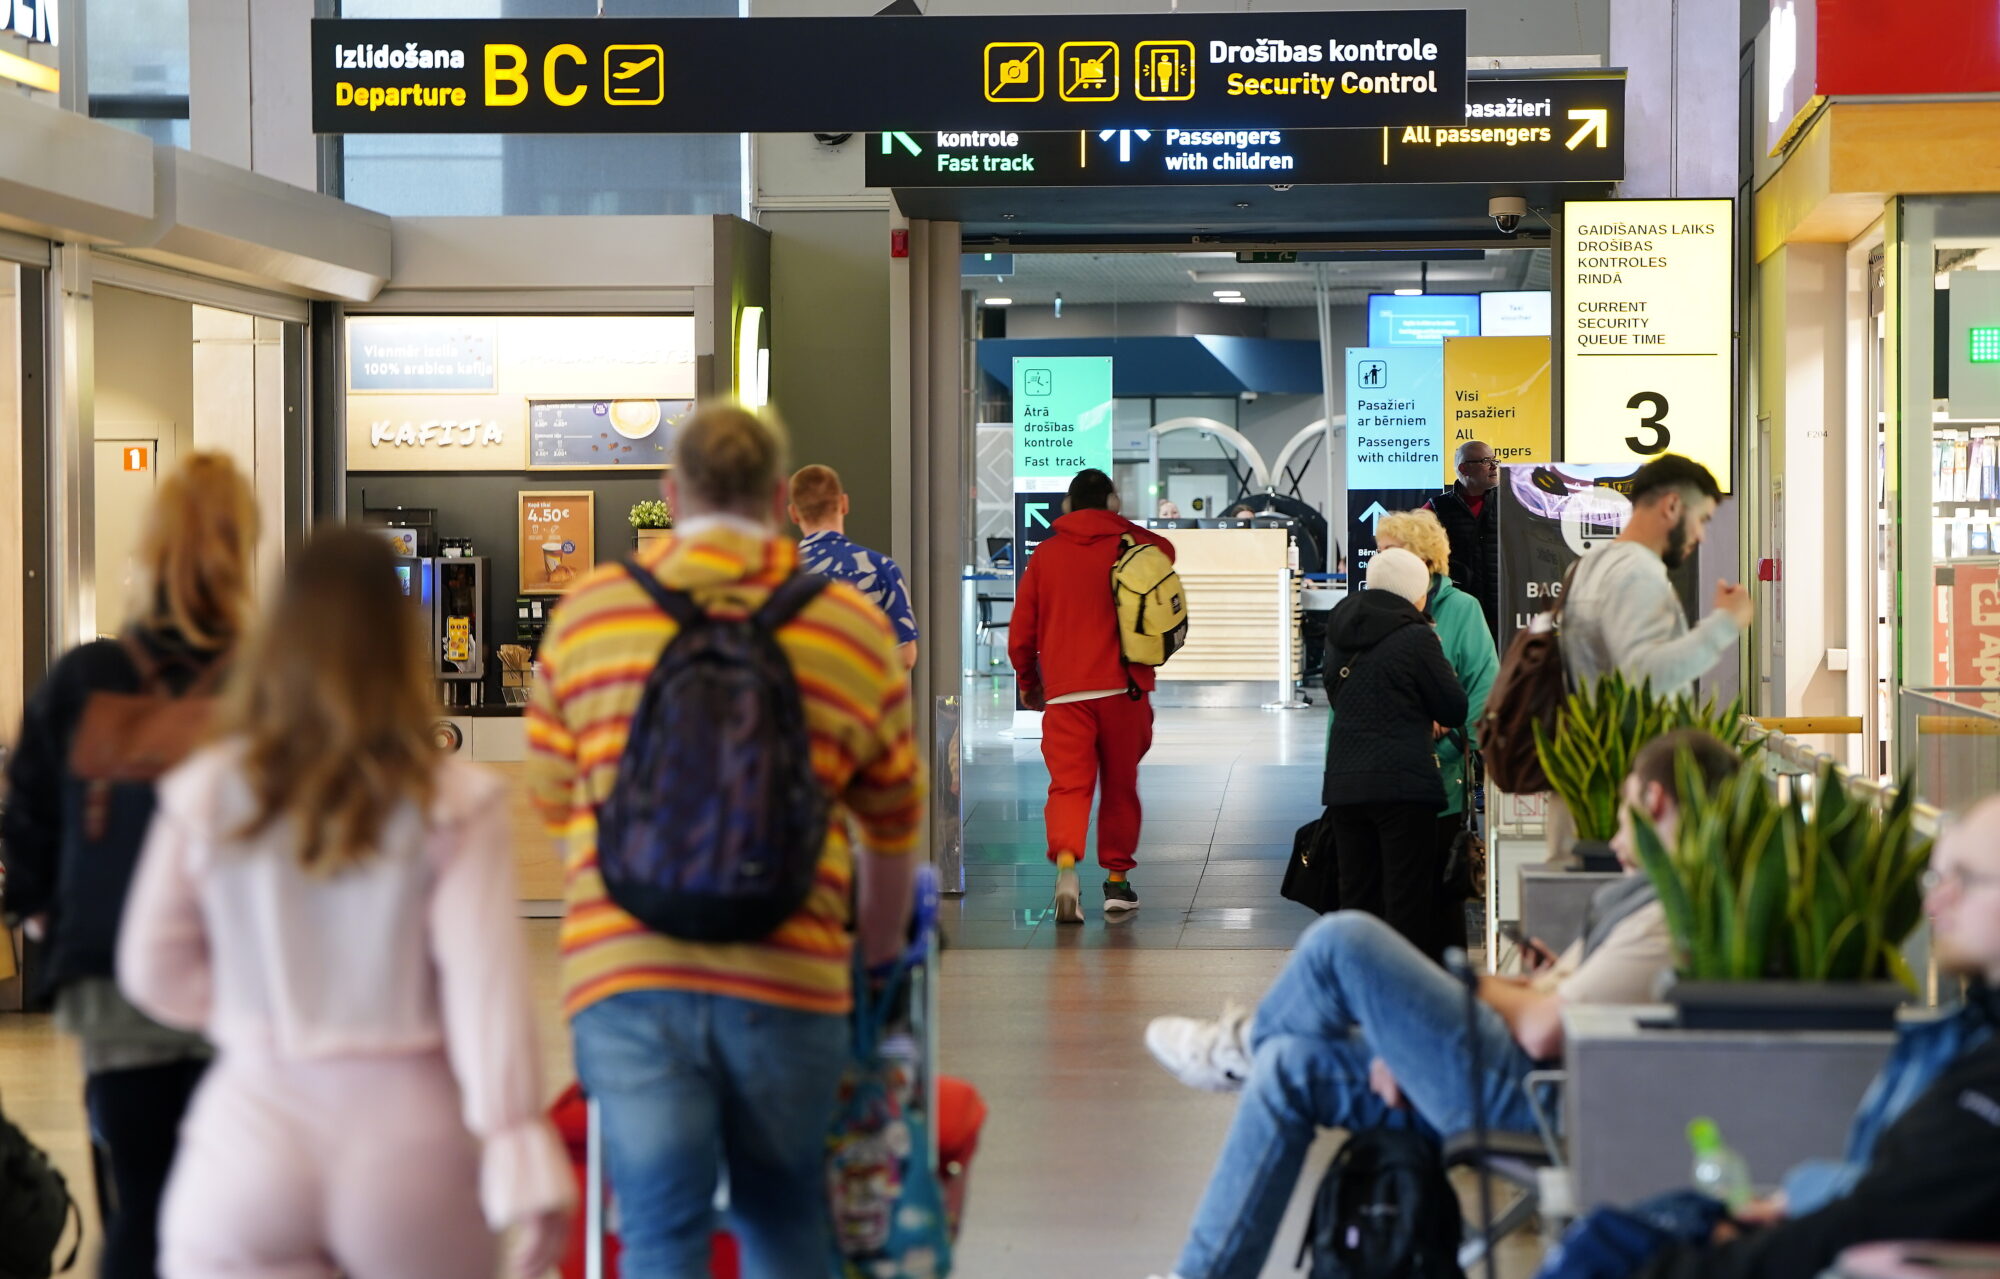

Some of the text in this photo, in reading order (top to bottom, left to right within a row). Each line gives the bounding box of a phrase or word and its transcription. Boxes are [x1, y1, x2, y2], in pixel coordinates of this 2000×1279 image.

[335, 43, 465, 69] Izlidošana
[1209, 38, 1438, 64] Drošības kontrole
[484, 43, 588, 107] B C
[1227, 70, 1438, 99] Security Control
[336, 82, 466, 111] Departure
[937, 131, 1019, 148] kontrole
[1166, 128, 1281, 149] Passengers
[1402, 125, 1551, 147] All passengers
[937, 153, 1034, 172] Fast track
[1165, 152, 1294, 171] with children
[1578, 222, 1715, 235] GAIDĪŠANAS LAIKS
[1578, 239, 1653, 252] DROŠĪBAS
[1578, 257, 1667, 268] KONTROLES
[1578, 271, 1622, 284] RINDĀ
[1578, 301, 1647, 313] CURRENT
[1578, 318, 1649, 329] SECURITY
[1578, 334, 1666, 347] QUEUE TIME
[364, 363, 399, 375] 100%
[1456, 391, 1479, 401] Visi
[1024, 404, 1049, 417] Ātrā
[1358, 399, 1415, 411] Pasažieri
[1456, 406, 1515, 420] pasažieri
[1024, 421, 1074, 432] drošības
[1358, 415, 1427, 426] ar bērniem
[1625, 391, 1671, 456] 3
[371, 420, 503, 448] KAFIJA
[1456, 429, 1474, 440] All
[1024, 437, 1073, 448] kontrole
[1358, 436, 1430, 449] Passengers
[129, 448, 141, 470] 1
[1025, 456, 1086, 466] Fast track
[1358, 452, 1439, 462] with children
